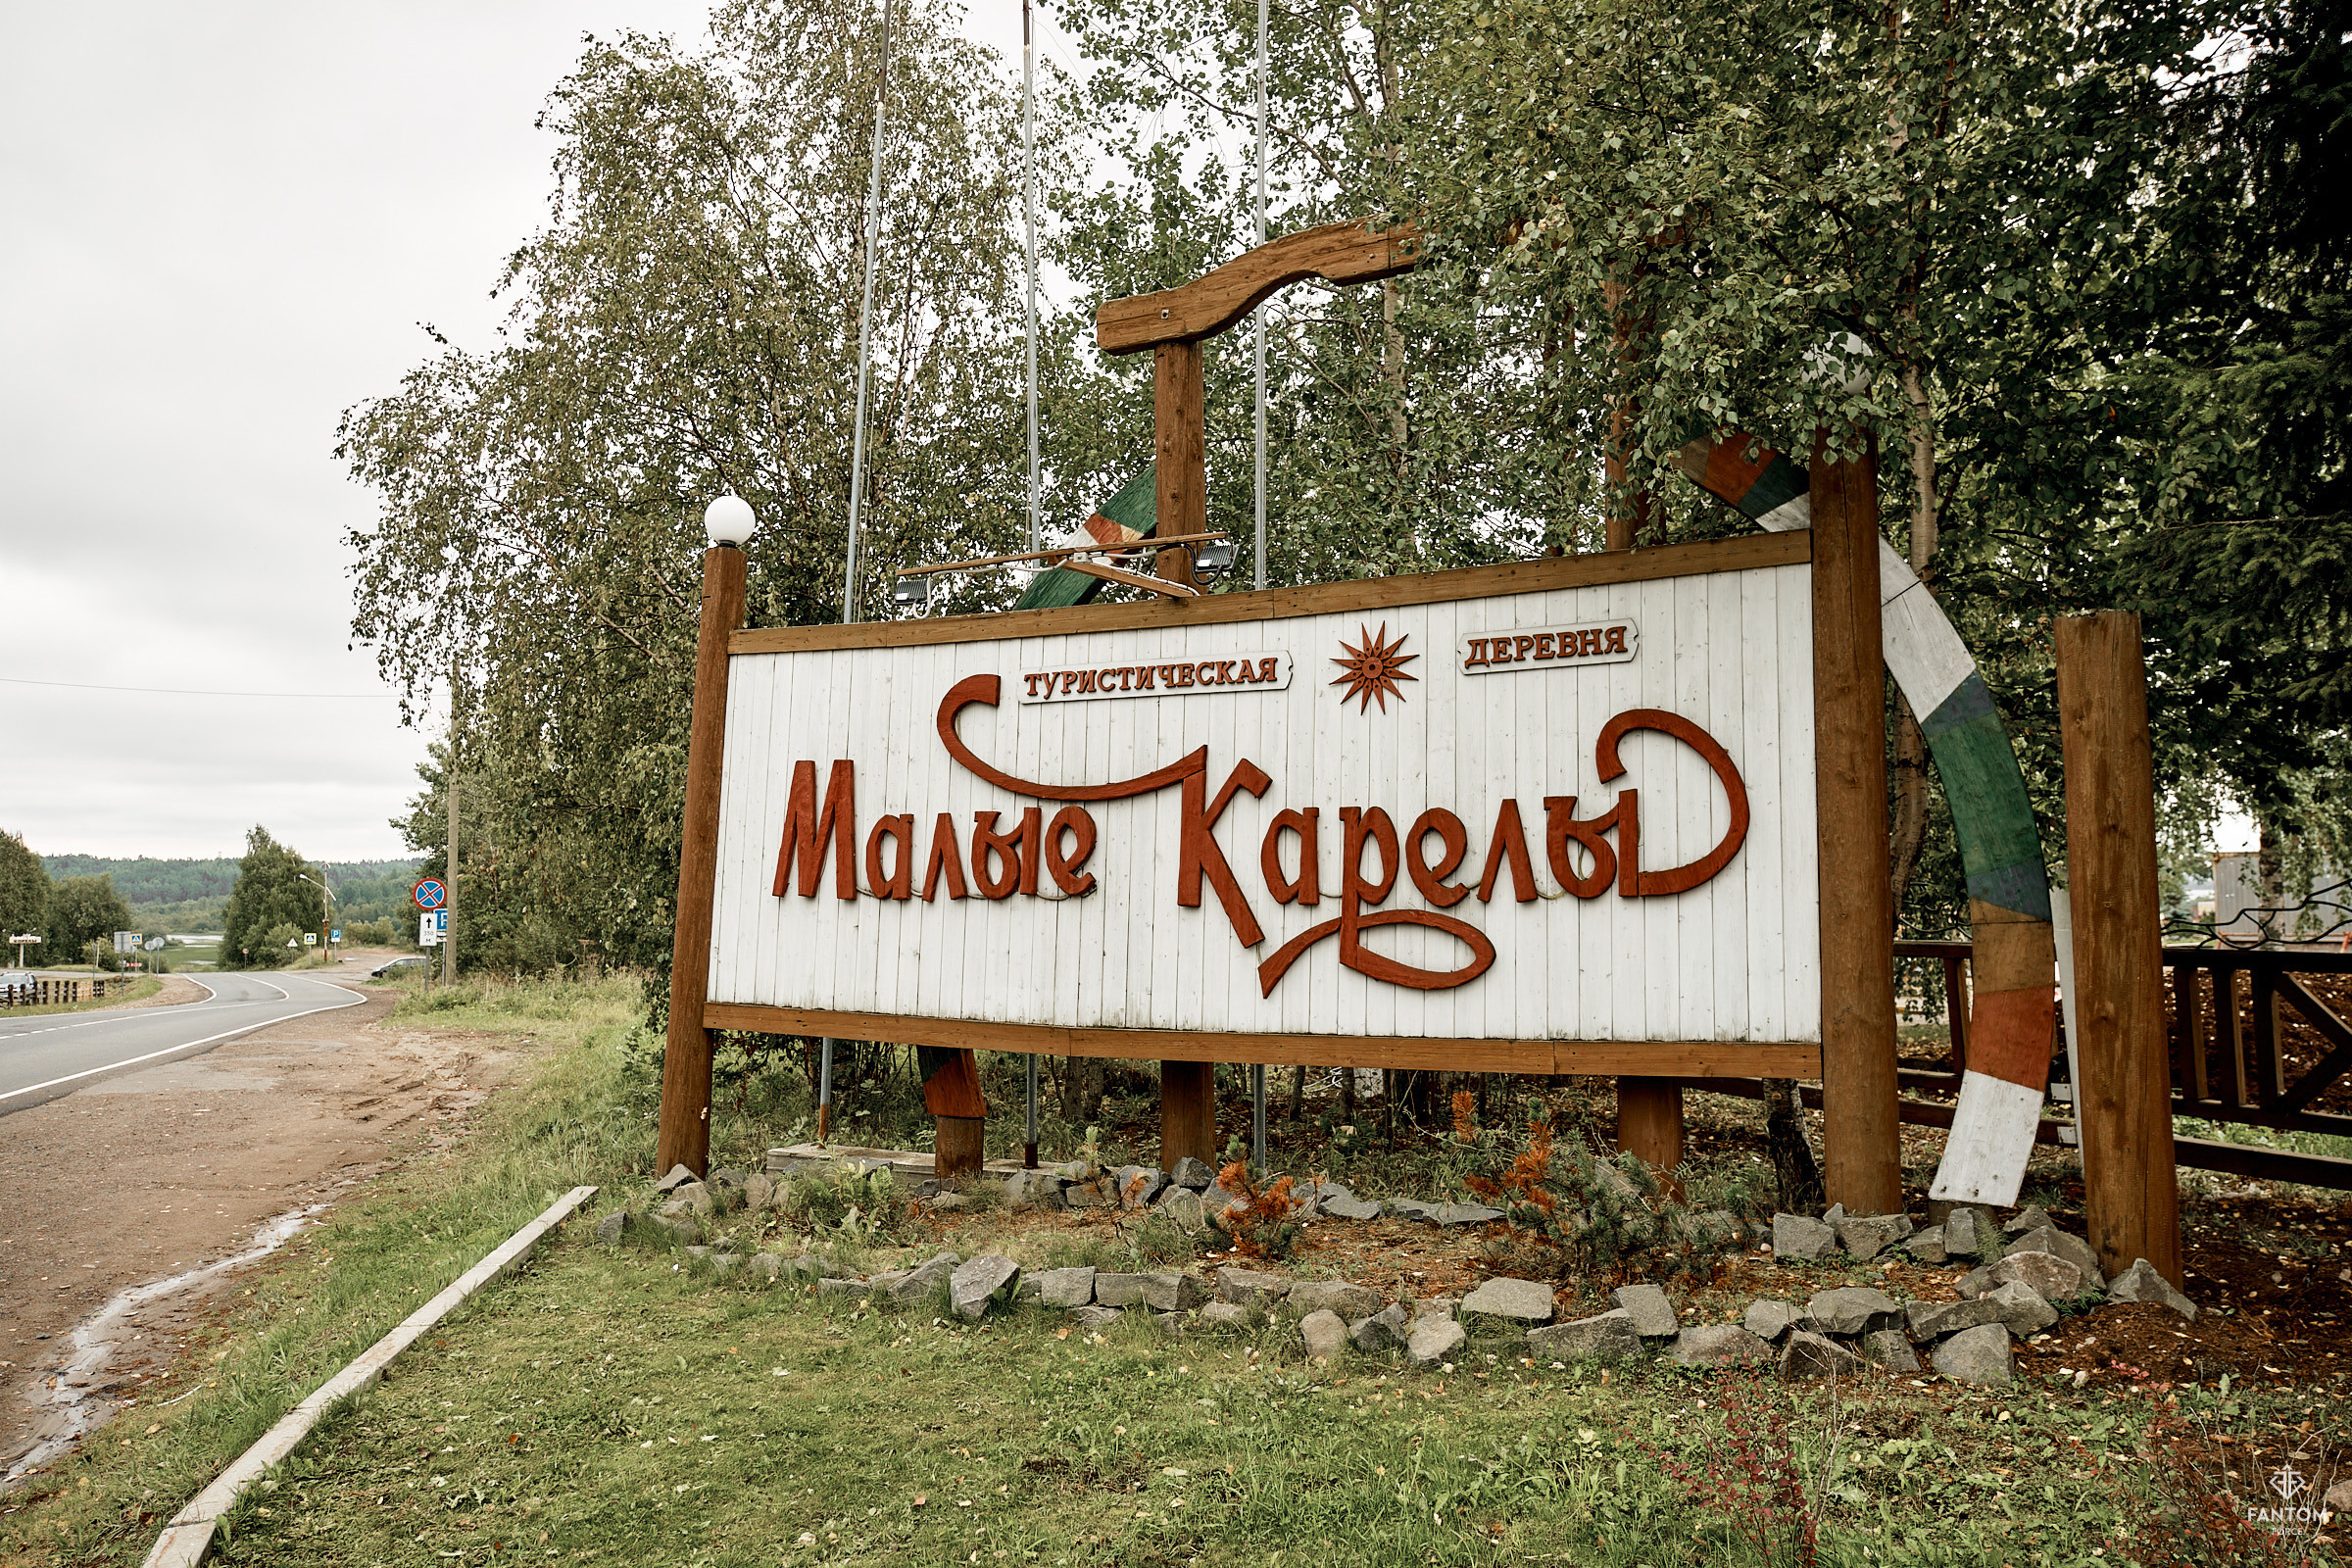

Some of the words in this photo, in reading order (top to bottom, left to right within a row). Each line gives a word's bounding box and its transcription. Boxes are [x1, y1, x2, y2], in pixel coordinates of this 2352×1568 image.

[1024, 657, 1279, 699] ТУРИСТИЧЕСКАЯ
[1464, 625, 1629, 669] ДЕРЕВНЯ
[771, 759, 1099, 903] Малые
[937, 673, 1749, 999] Карелы
